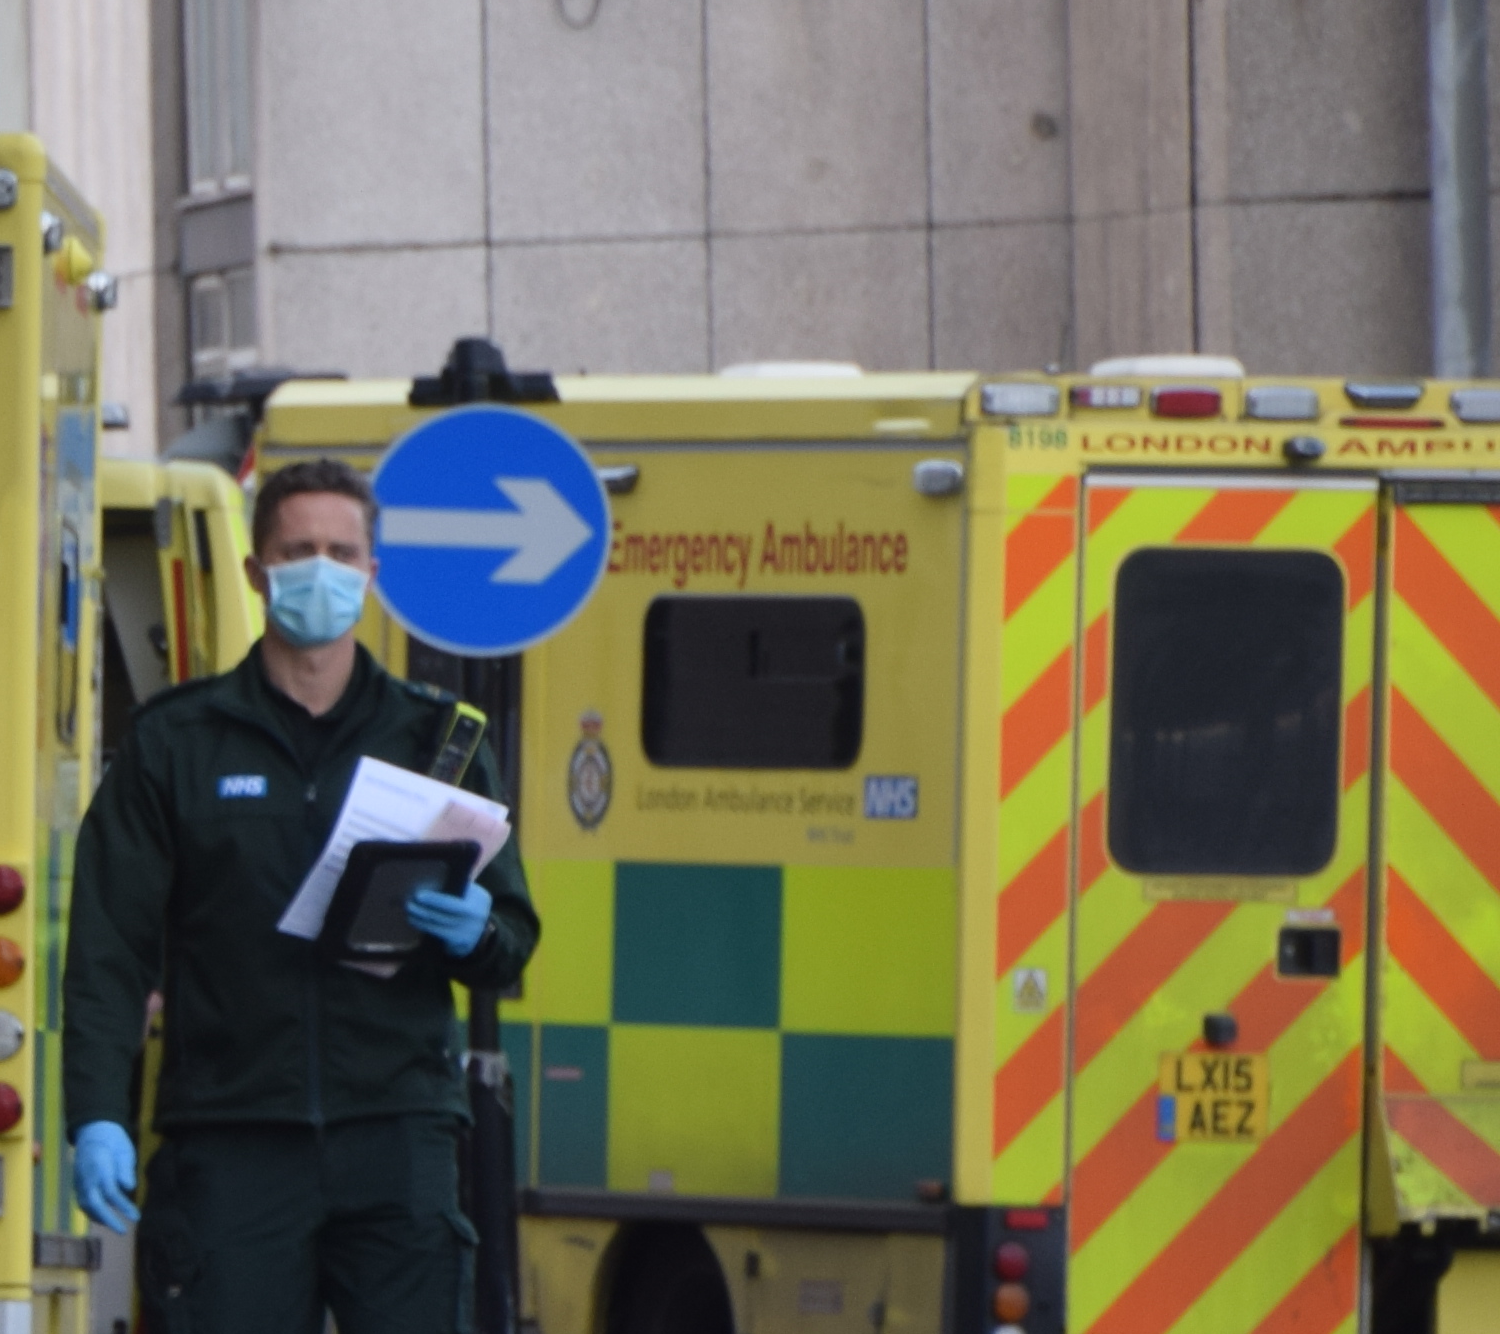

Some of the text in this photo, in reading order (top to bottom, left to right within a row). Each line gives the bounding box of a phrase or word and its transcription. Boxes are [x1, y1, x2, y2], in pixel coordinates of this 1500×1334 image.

[1081, 433, 1272, 455] LONDON
[607, 520, 908, 590] Emergency Ambulance
[220, 776, 266, 798] NHS
[865, 775, 917, 816] NHS
[1174, 1057, 1254, 1093] LX15
[1188, 1099, 1257, 1136] AEZ
